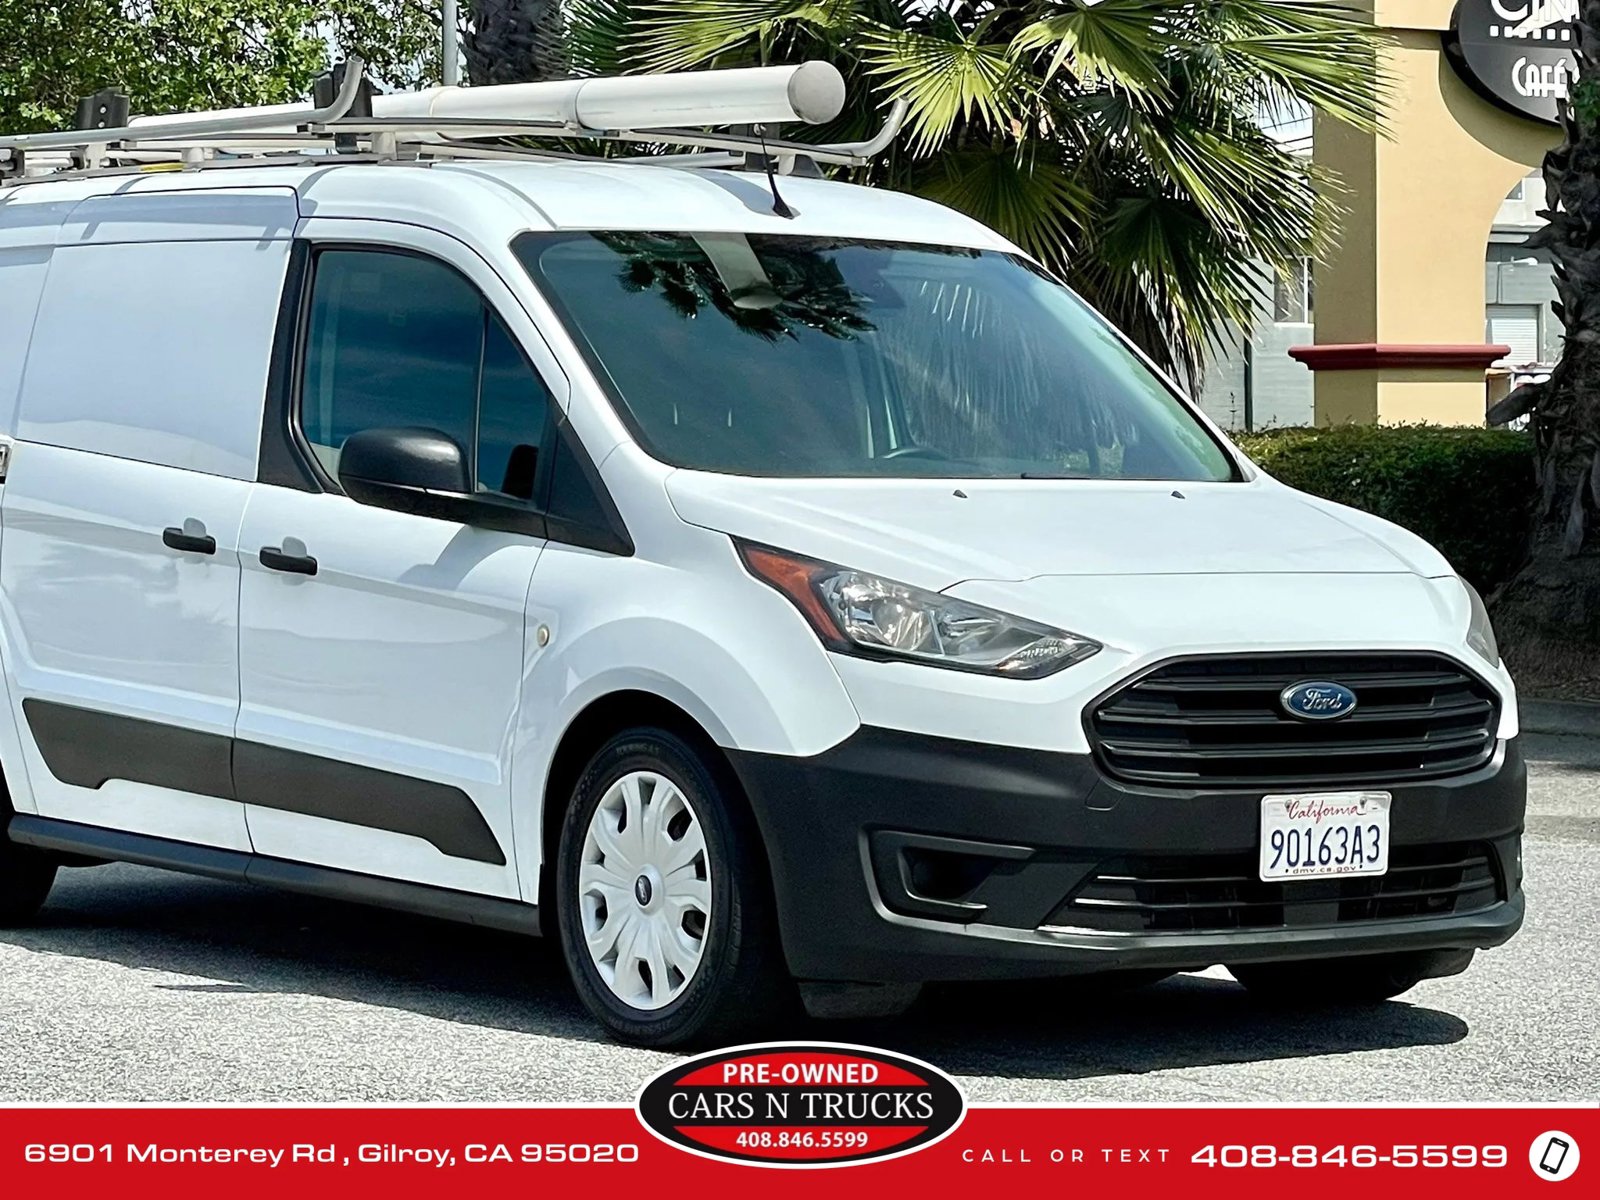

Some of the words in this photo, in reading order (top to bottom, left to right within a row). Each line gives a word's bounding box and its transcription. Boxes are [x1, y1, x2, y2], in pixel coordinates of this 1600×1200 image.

[1303, 688, 1342, 710] Ford
[1289, 800, 1366, 824] California
[1270, 825, 1381, 869] 90163A3
